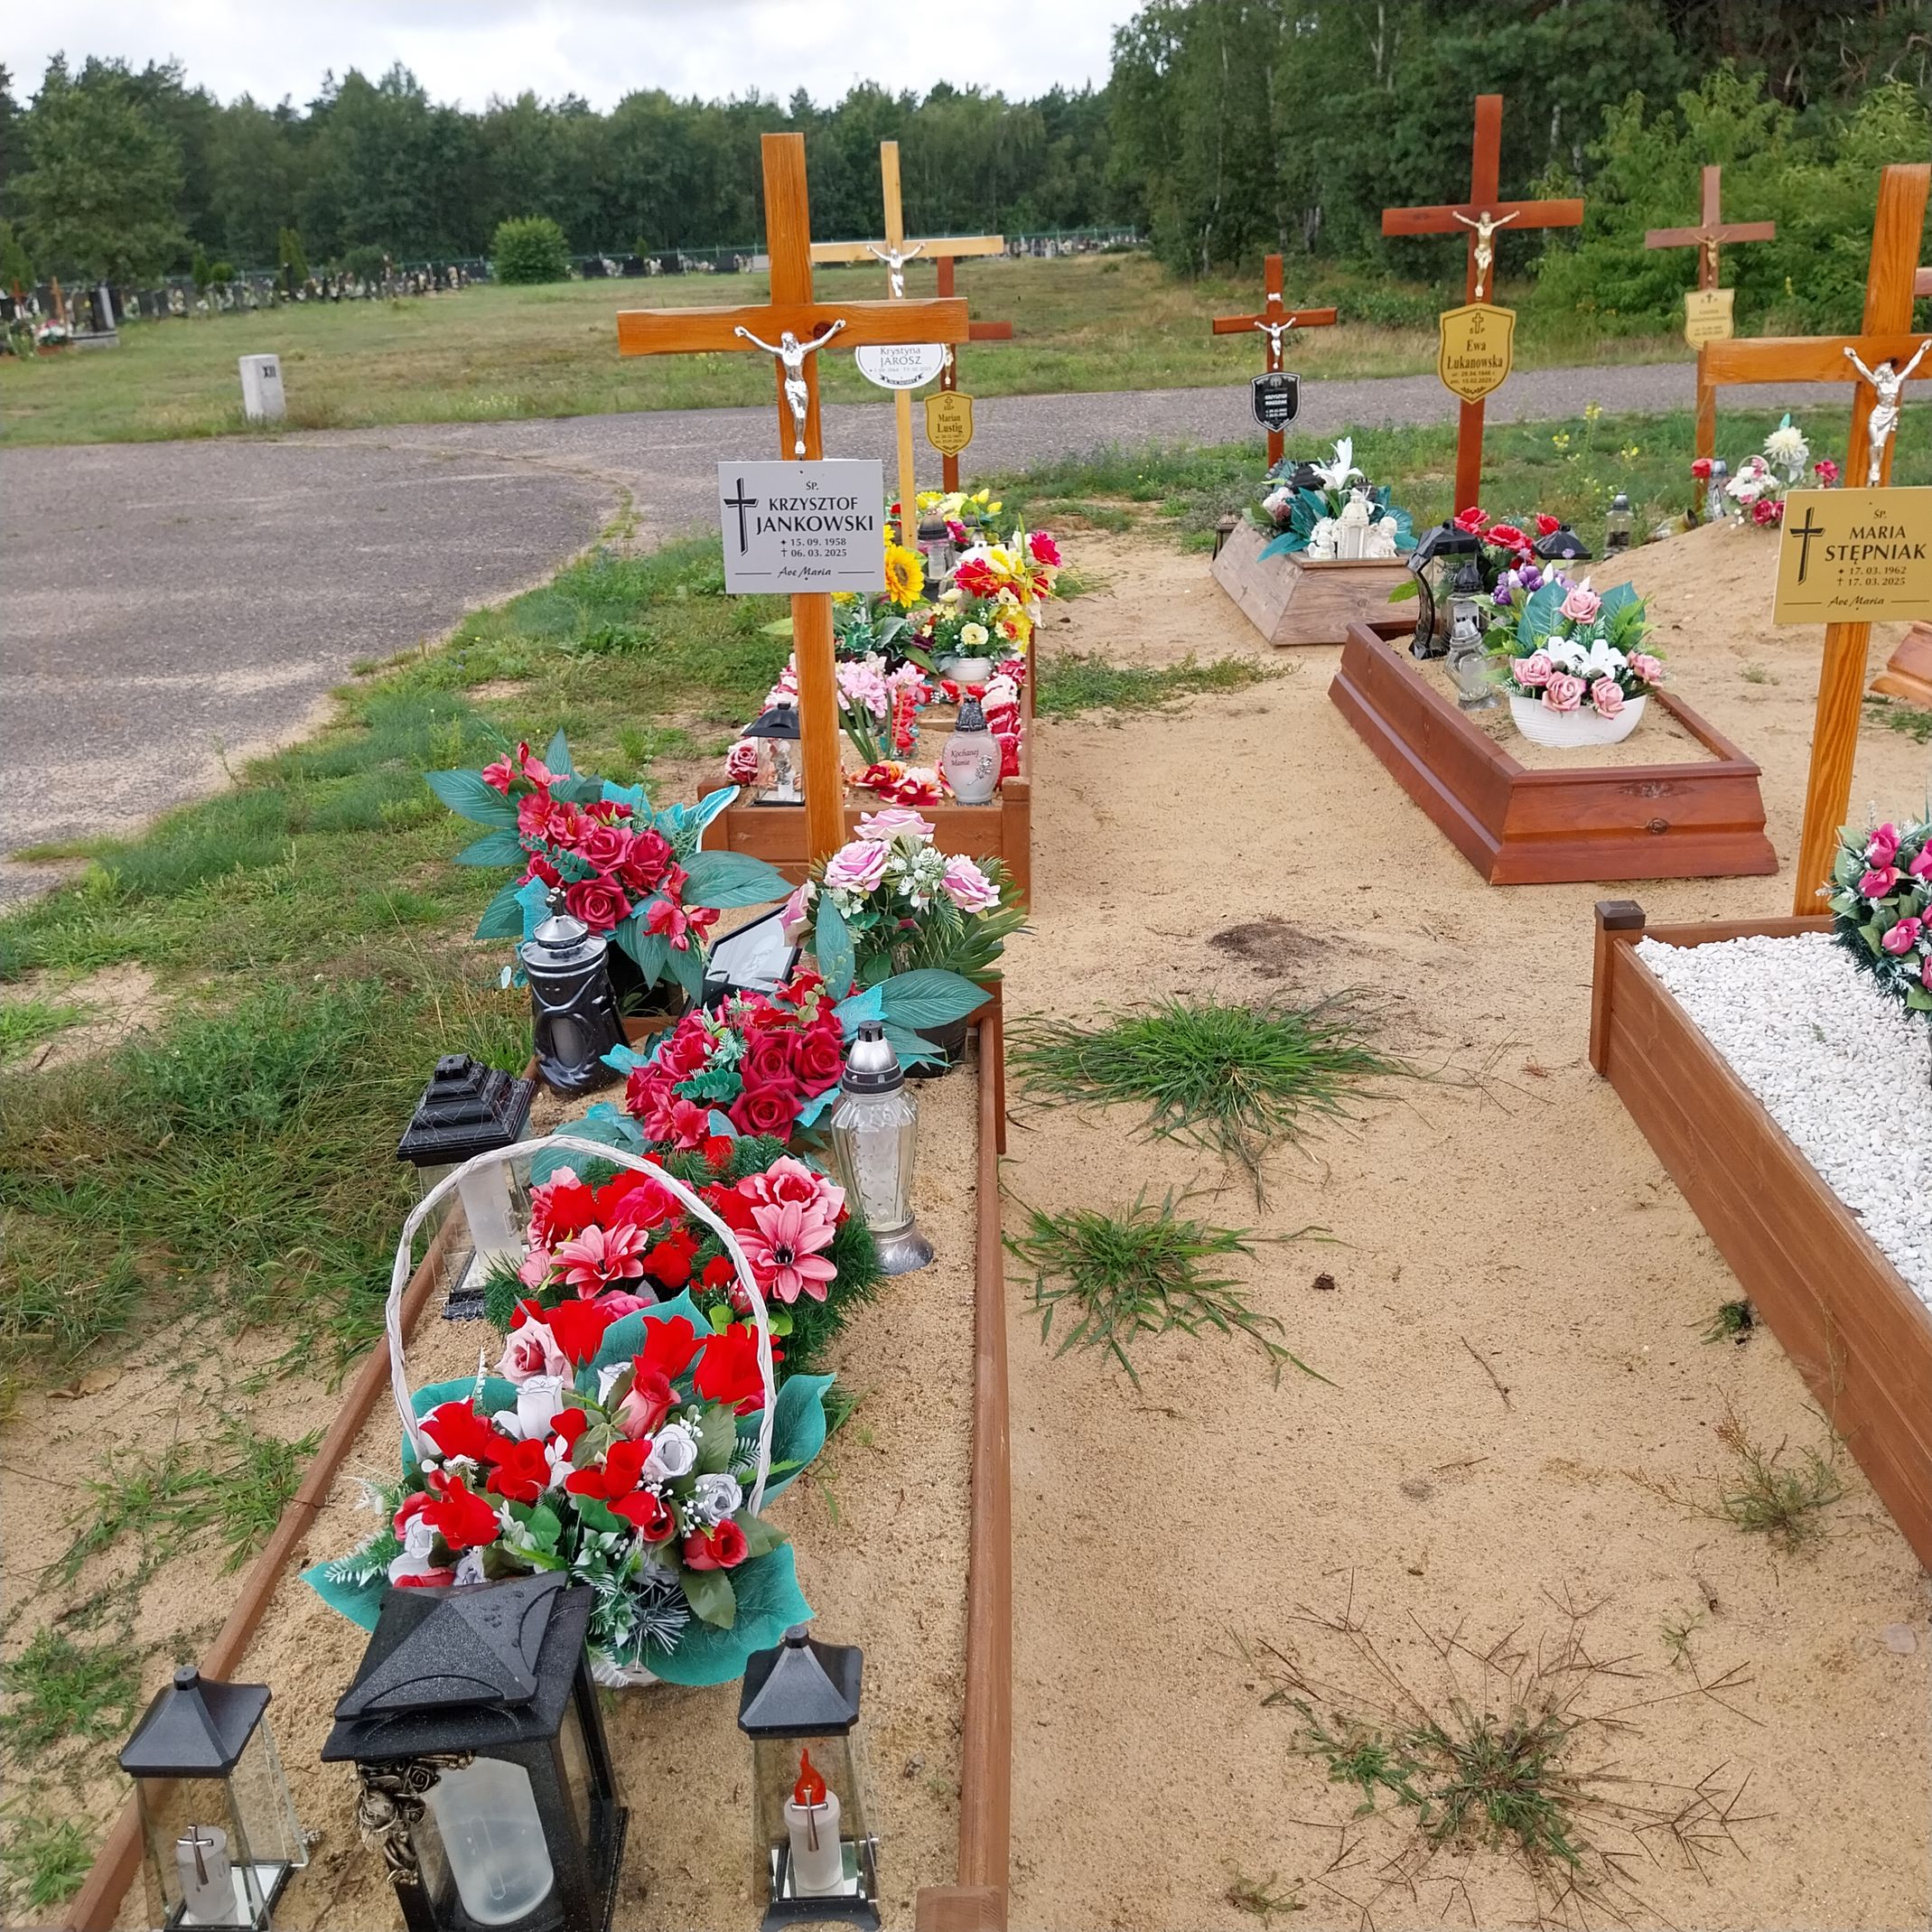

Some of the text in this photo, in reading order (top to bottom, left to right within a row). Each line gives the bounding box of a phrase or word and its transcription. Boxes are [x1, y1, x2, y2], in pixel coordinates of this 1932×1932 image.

[880, 347, 921, 356] Krystyna
[1466, 339, 1487, 351] Ewa
[880, 356, 922, 368] JAROSZ
[938, 413, 961, 422] Marian
[937, 423, 963, 434] Lustig
[769, 497, 858, 511] KRZYSZTOF
[756, 515, 873, 535] JANKOWSKI
[1849, 526, 1907, 540] MARIA
[1825, 543, 1927, 565] STĘPNIAK
[778, 565, 832, 578] Ave Maria
[1827, 595, 1885, 608] Ave Maria
